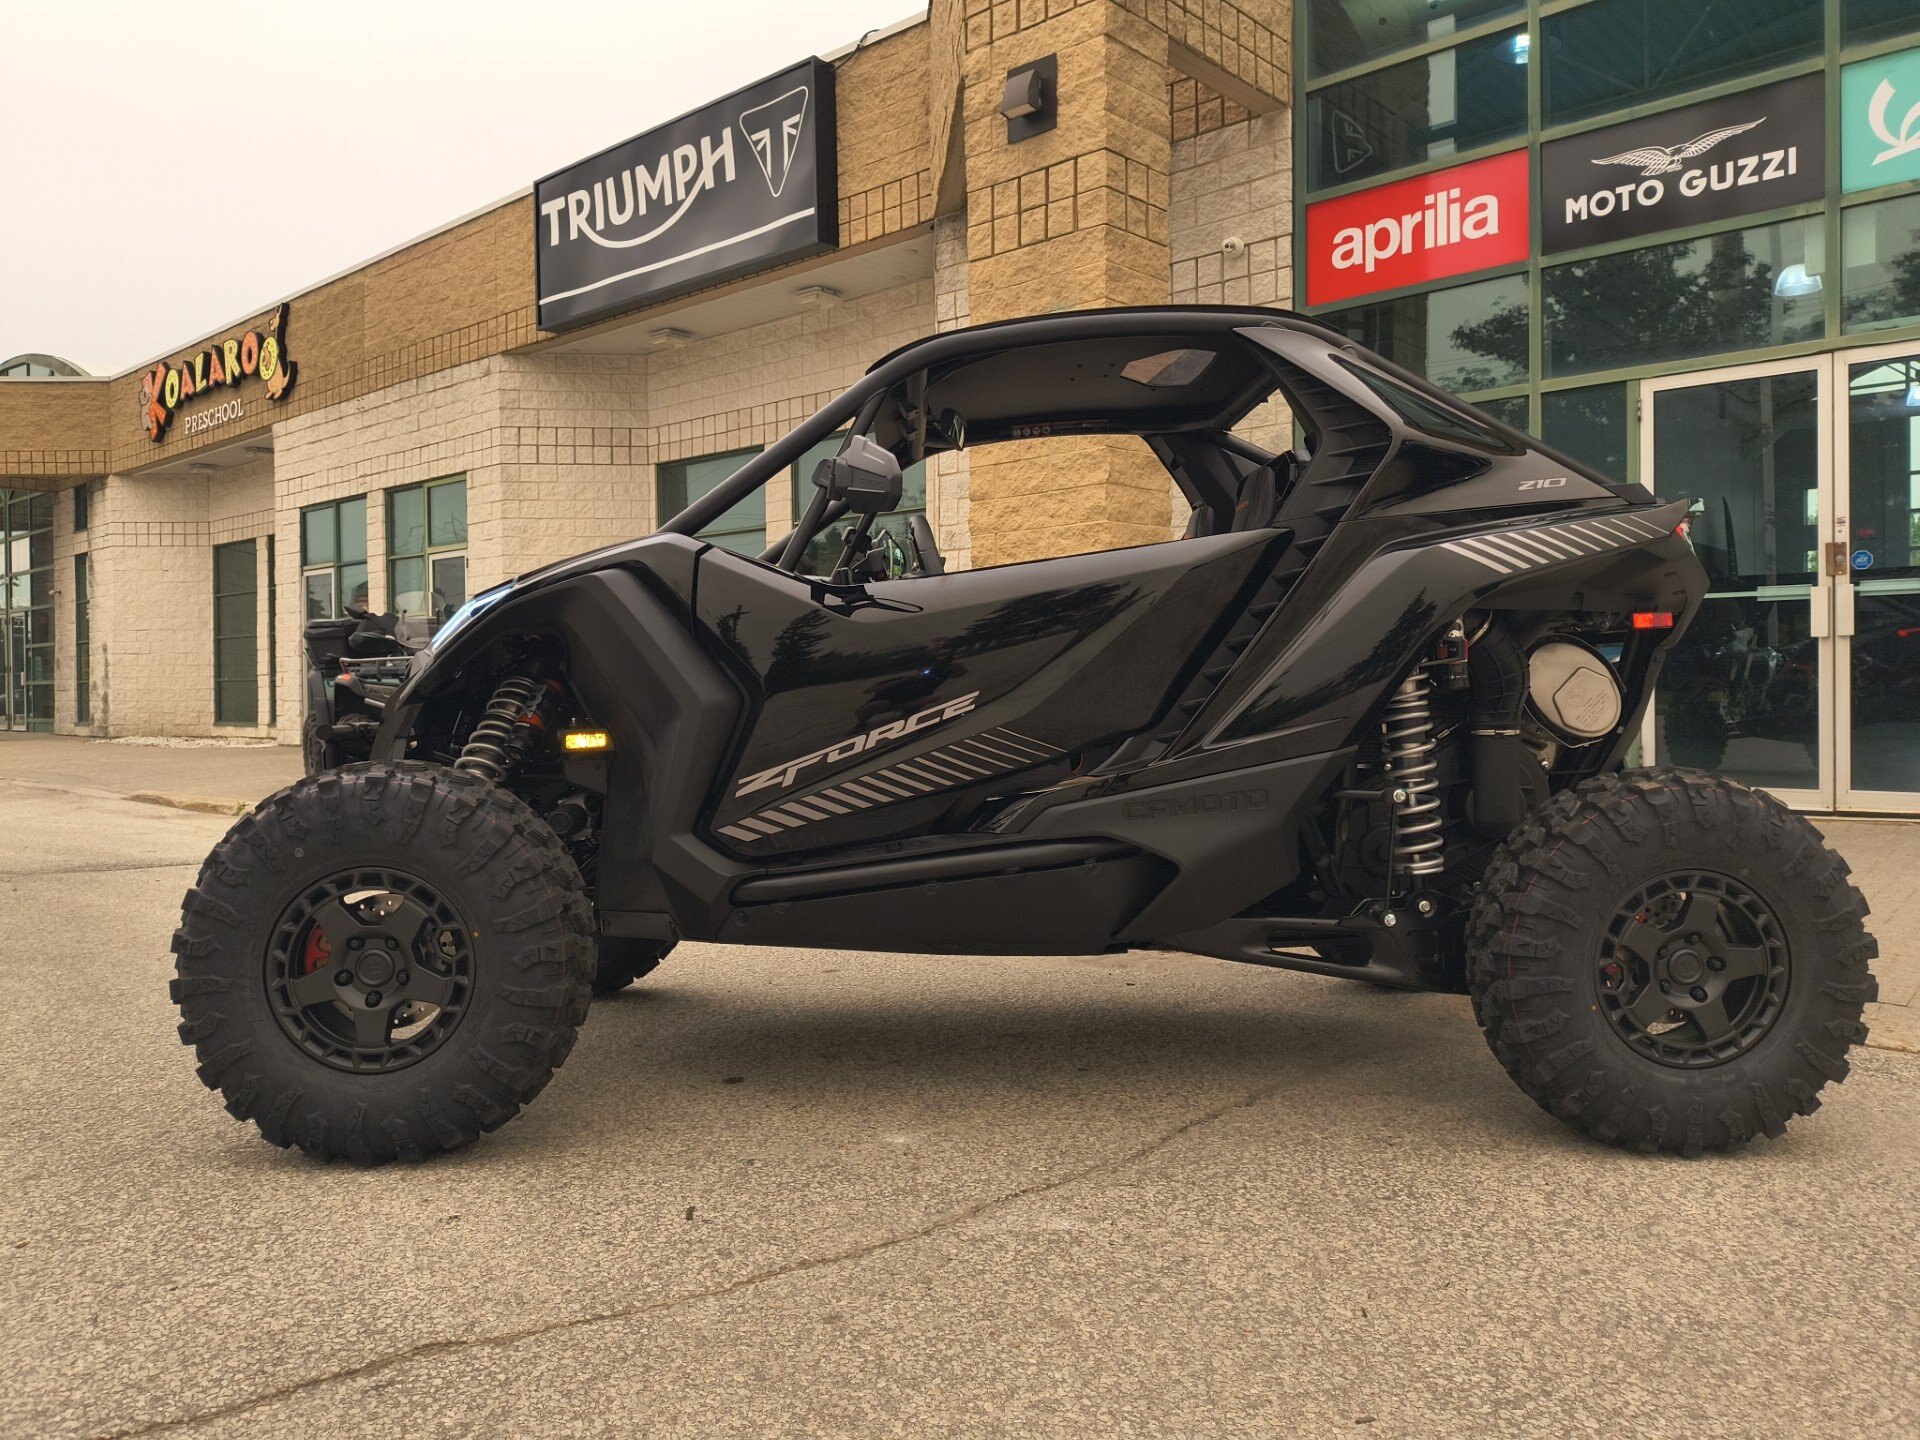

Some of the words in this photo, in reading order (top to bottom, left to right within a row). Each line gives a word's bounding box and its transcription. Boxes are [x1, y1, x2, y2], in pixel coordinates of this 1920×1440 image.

[541, 126, 735, 249] TRIUMPH
[1565, 179, 1664, 224] MOTO
[1679, 146, 1797, 197] GUZZI
[1331, 187, 1499, 273] aprilia
[142, 331, 279, 441] KOALAROO
[184, 398, 244, 434] PRESCHOOL
[1518, 477, 1567, 491] Z10
[735, 691, 980, 798] ZFORCE
[1121, 787, 1270, 821] CFMOTO
